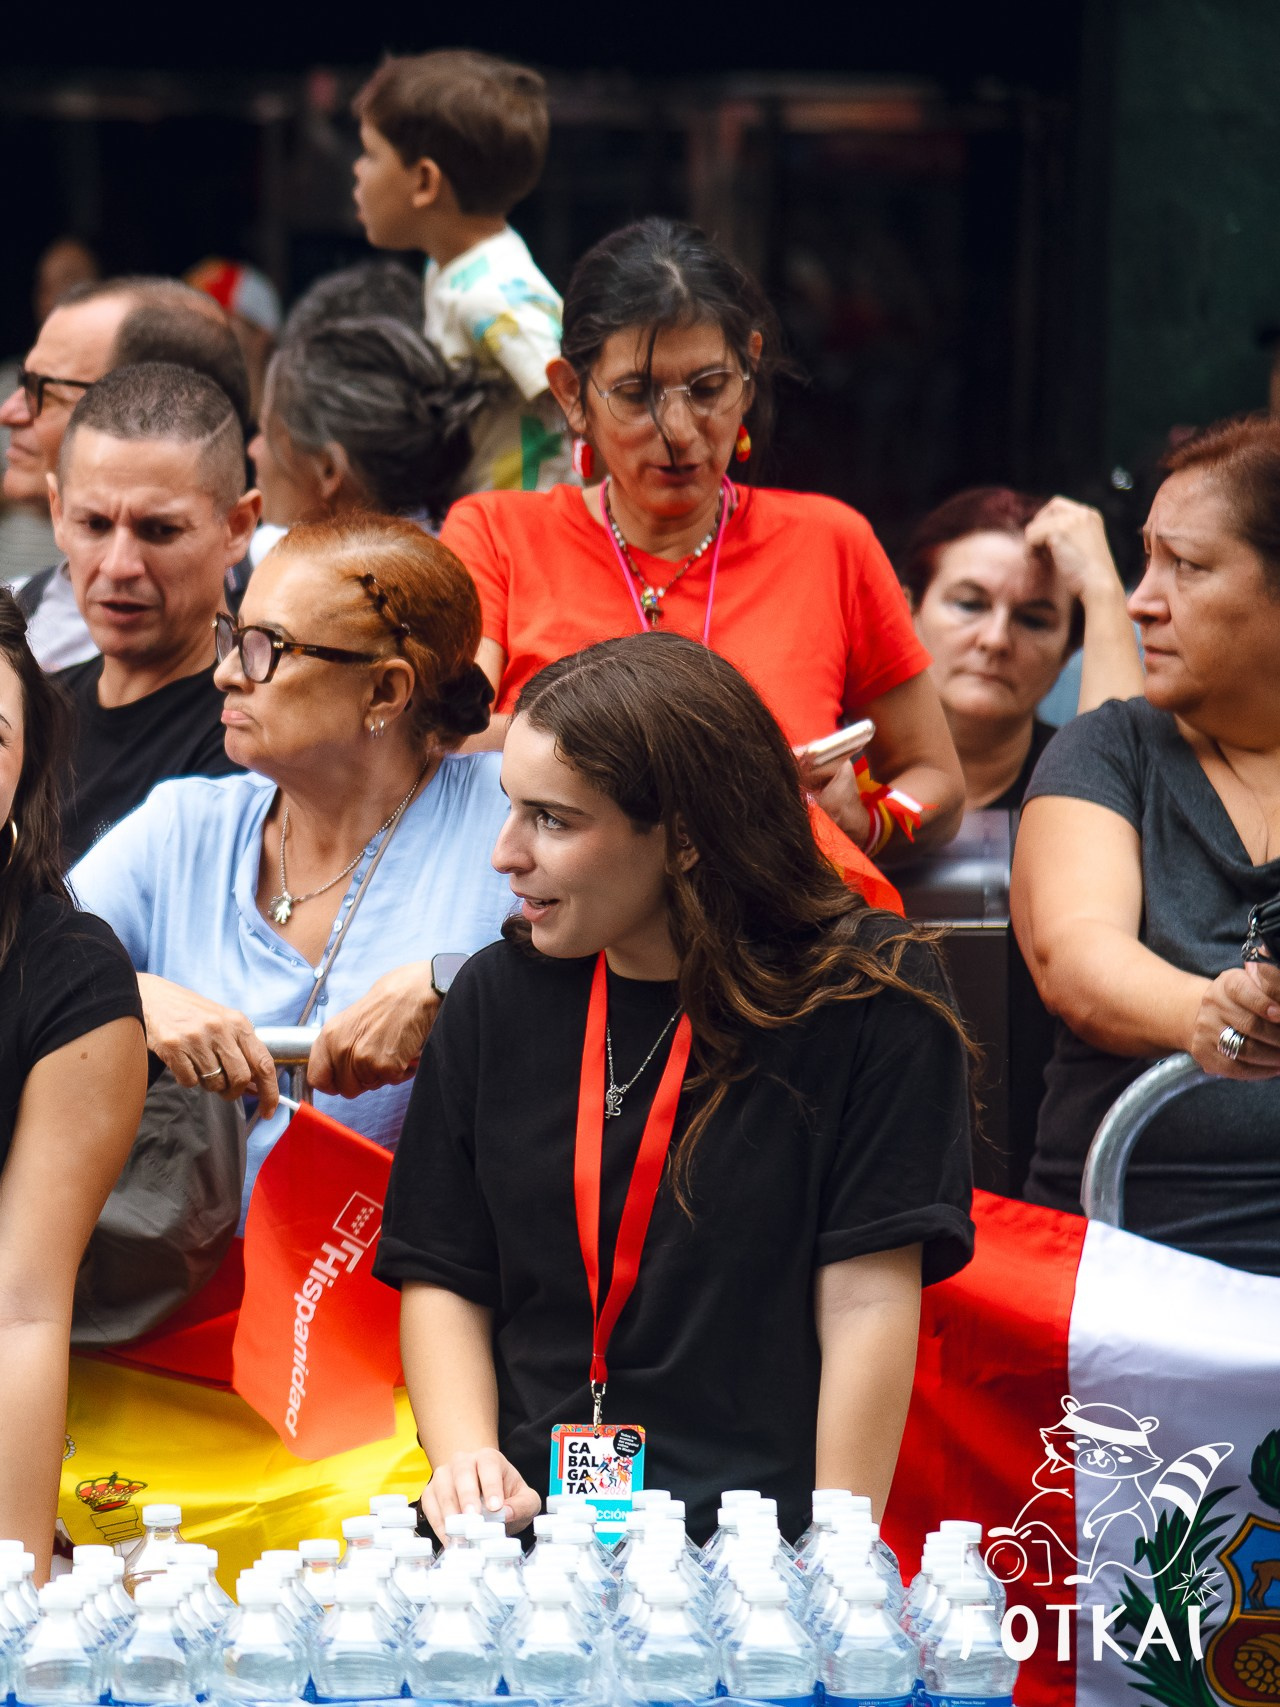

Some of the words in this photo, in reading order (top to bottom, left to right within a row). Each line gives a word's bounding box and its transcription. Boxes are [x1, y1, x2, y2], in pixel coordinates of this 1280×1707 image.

[285, 1242, 349, 1439] Hispanidad
[568, 1442, 591, 1454] CA
[568, 1456, 599, 1467] BAL
[567, 1469, 590, 1481] GA
